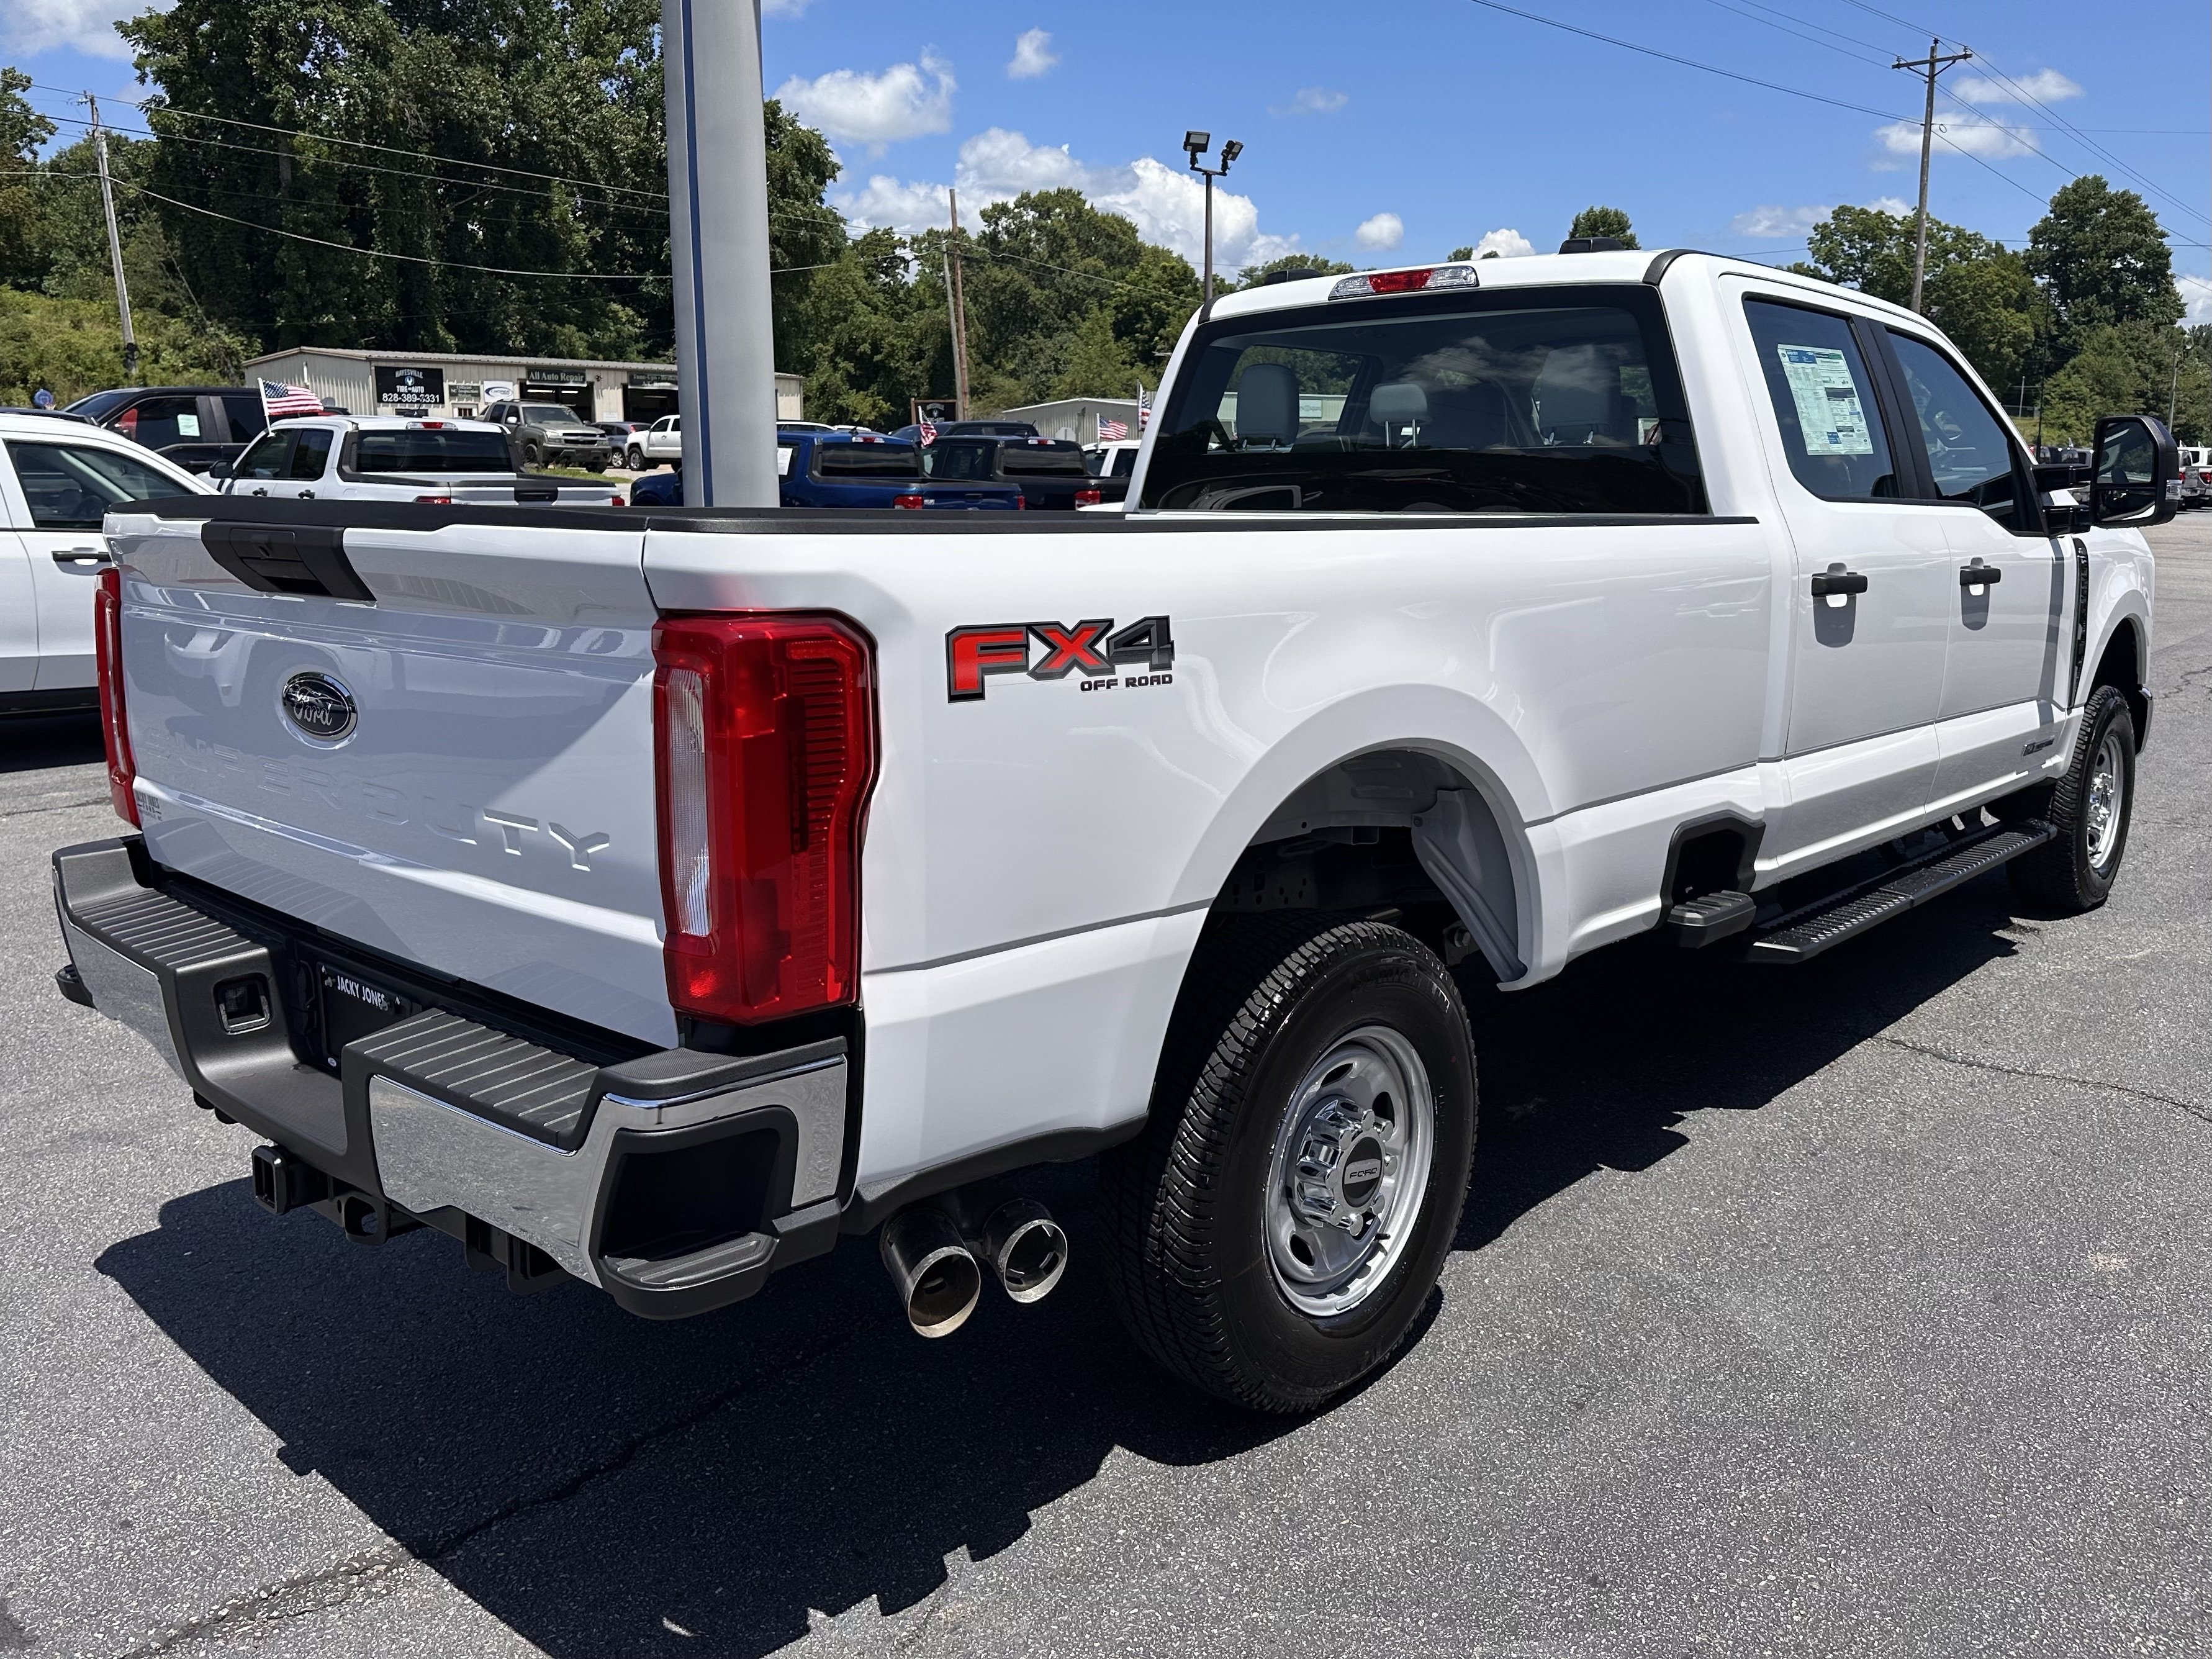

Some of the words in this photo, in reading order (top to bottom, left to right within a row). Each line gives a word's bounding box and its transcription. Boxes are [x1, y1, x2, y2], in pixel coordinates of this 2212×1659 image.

[529, 371, 540, 380] All
[541, 372, 559, 381] Auto
[560, 373, 584, 382] Repair
[382, 393, 440, 403] 828-389-3331
[946, 615, 1175, 703] FX4
[1080, 679, 1118, 692] OFF
[1125, 674, 1173, 689] ROAD
[337, 975, 359, 998] JACKY
[362, 986, 385, 1008] JONES
[1350, 1167, 1378, 1178] FORD
